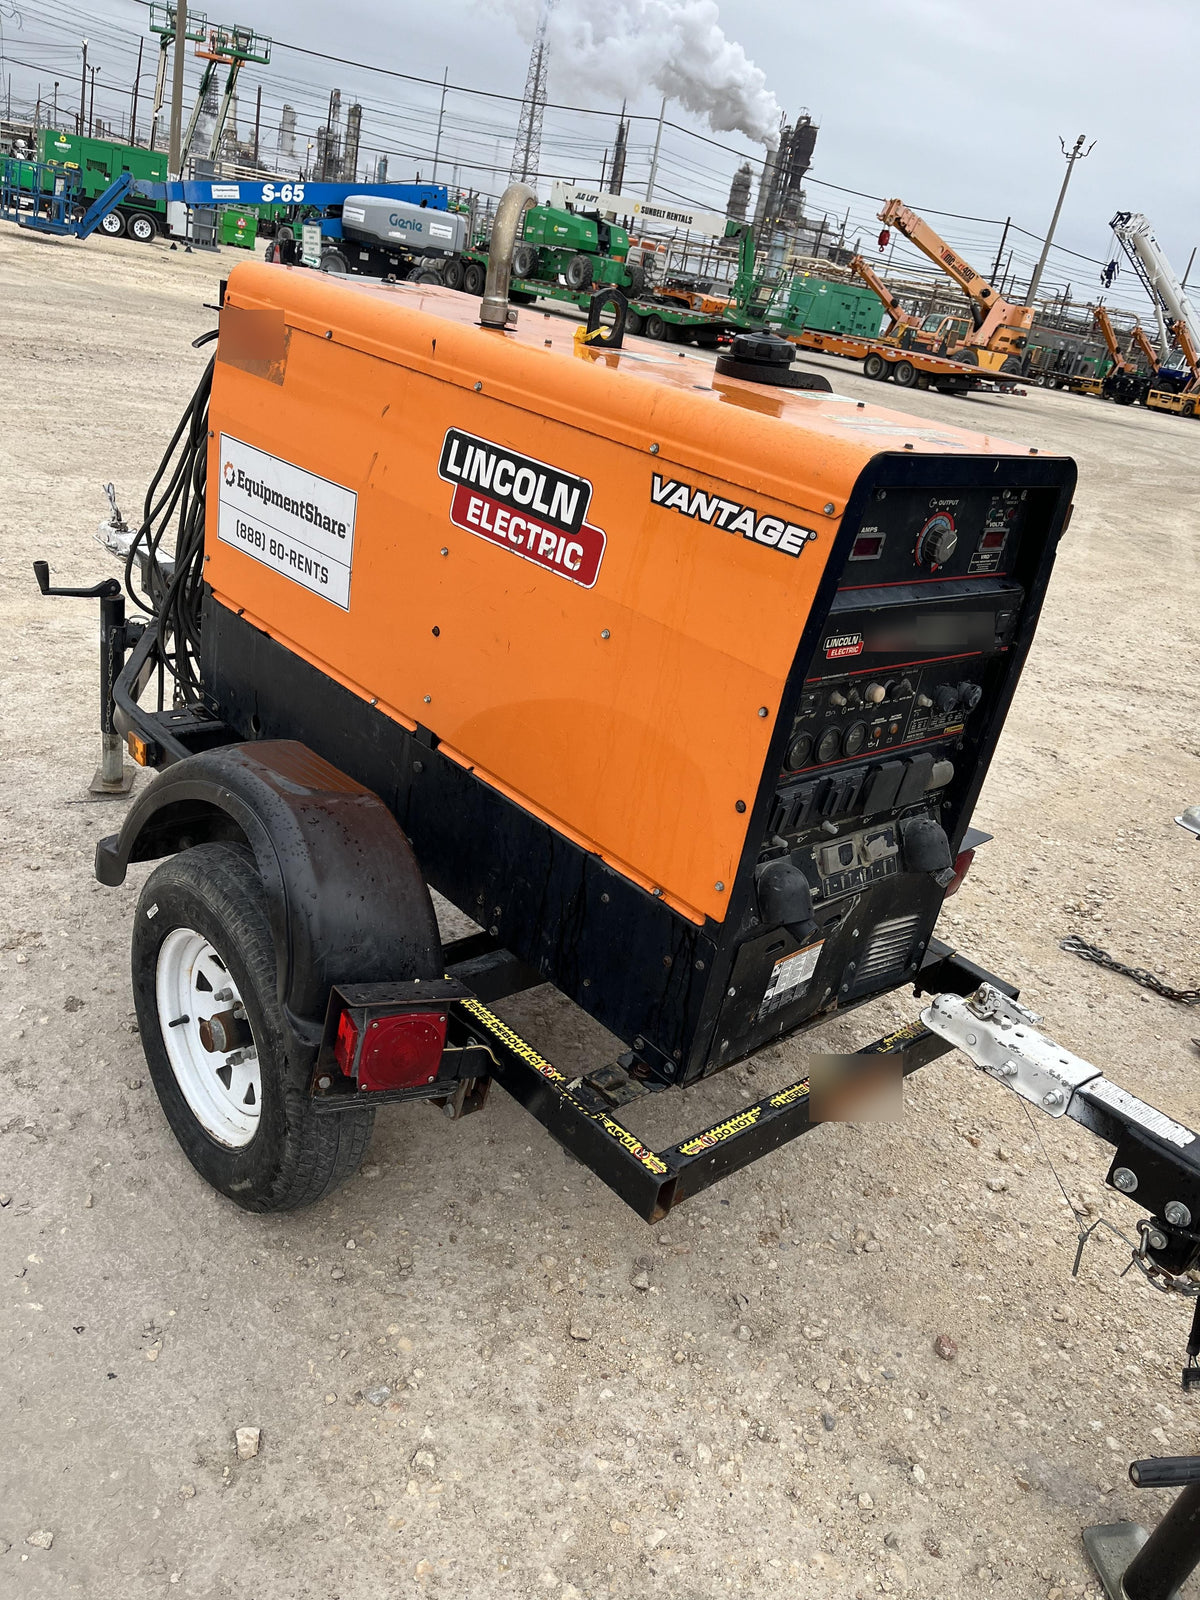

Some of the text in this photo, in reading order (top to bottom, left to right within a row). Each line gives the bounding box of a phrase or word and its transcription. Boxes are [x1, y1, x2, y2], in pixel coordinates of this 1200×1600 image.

[261, 183, 305, 203] S-65
[586, 194, 599, 203] LIFT
[389, 213, 423, 233] Genie
[641, 205, 693, 225] SUNBELT RENTALS
[446, 438, 581, 526] LINCOLN
[237, 468, 347, 540] EquipmentShare
[652, 474, 809, 556] VANTAGE
[466, 496, 584, 572] ELECTRIC
[236, 519, 329, 585] (888) 80-RENTS
[826, 635, 859, 648] LINCOLN
[831, 646, 859, 656] ELECTRIC
[781, 1086, 808, 1102] HERE
[714, 1117, 753, 1140] DO NOT
